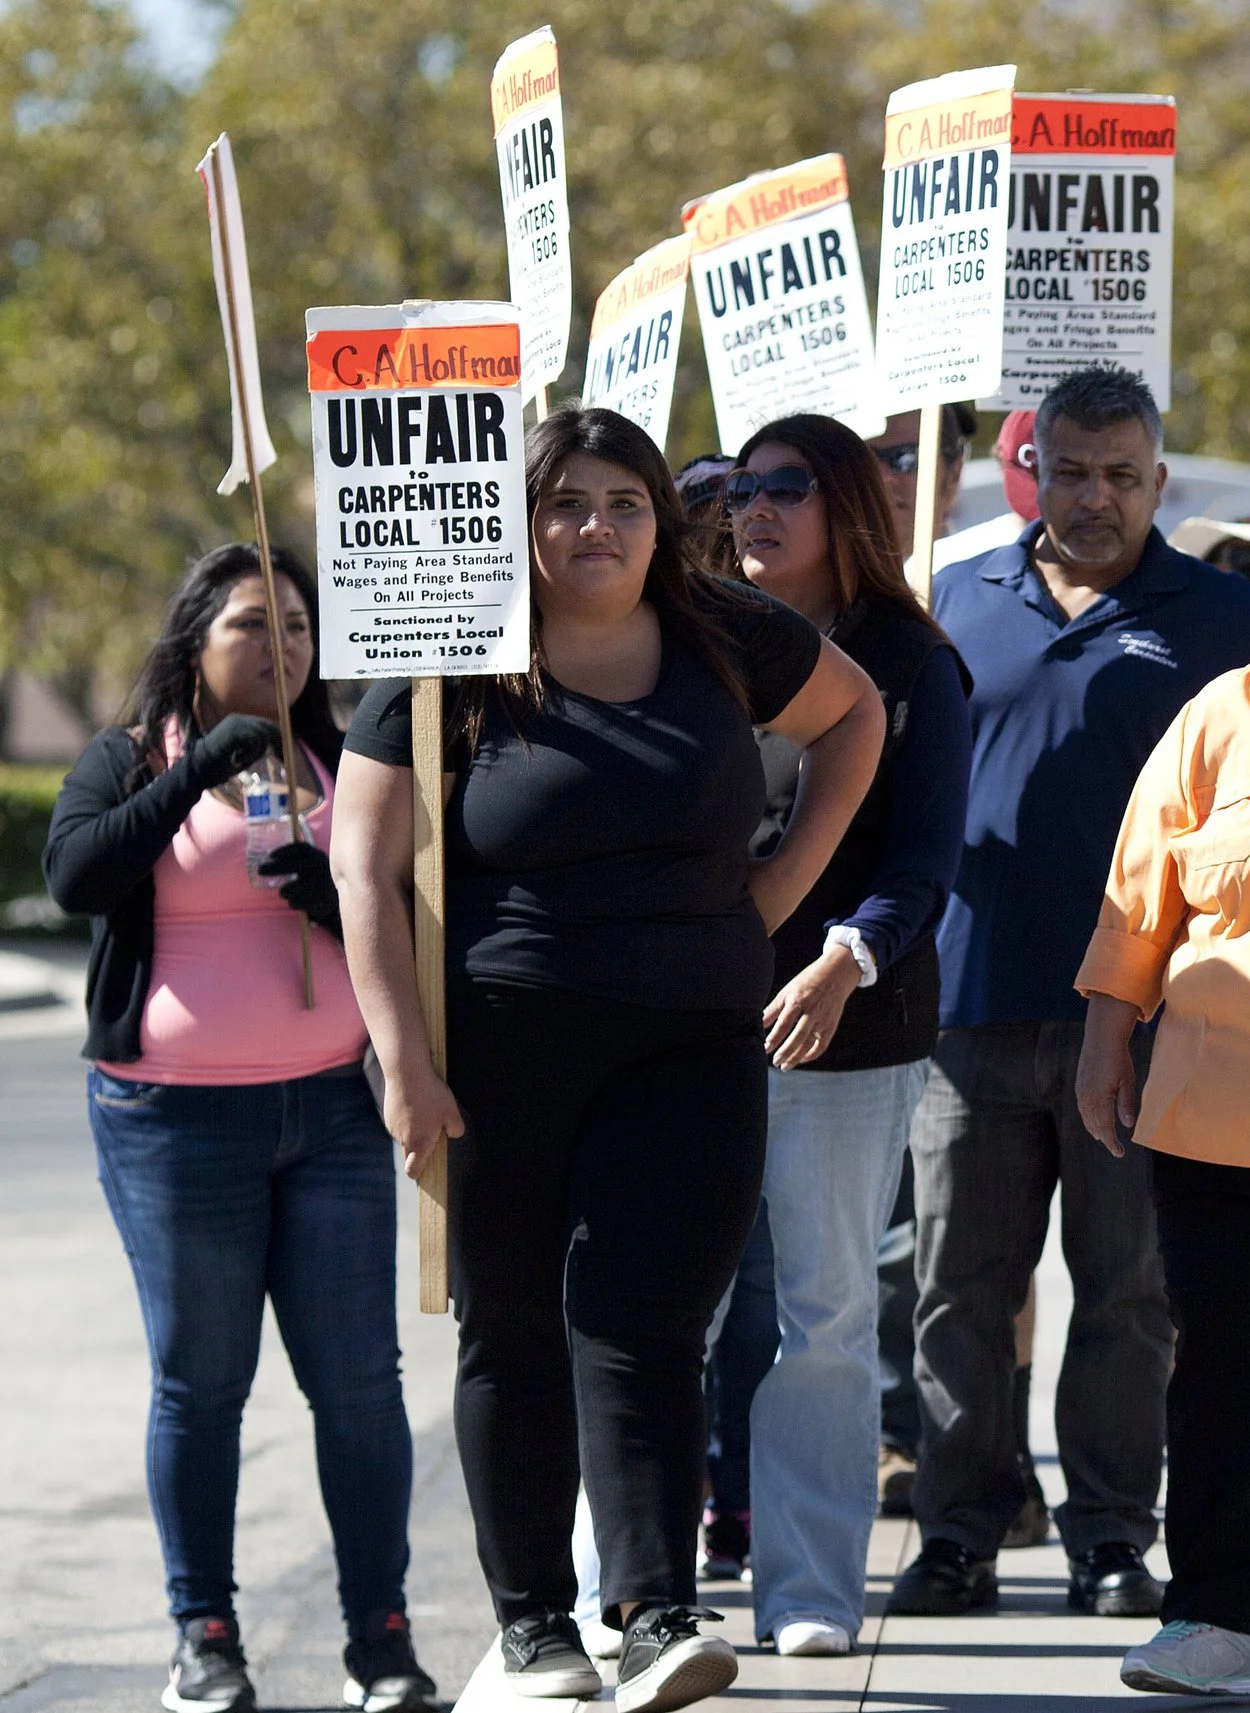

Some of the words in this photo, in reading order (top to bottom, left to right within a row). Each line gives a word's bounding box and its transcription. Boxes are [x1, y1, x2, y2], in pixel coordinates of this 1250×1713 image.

[1063, 113, 1175, 148] Hoffman
[892, 149, 999, 229] UNFAIR
[531, 231, 558, 265] 1506
[894, 227, 989, 269] CARPENTERS
[706, 229, 847, 318] UNFAIR
[895, 268, 935, 299] LOCAL
[1005, 277, 1074, 301] LOCAL
[722, 296, 845, 351] CARPENTERS
[1018, 309, 1058, 321] Paying
[1066, 309, 1095, 319] Area
[1101, 310, 1156, 320] Standard
[1035, 325, 1058, 334] and
[1063, 324, 1101, 336] Fringe
[1106, 324, 1155, 334] Benefits
[589, 309, 673, 403] UNFAIR
[730, 341, 786, 377] LOCAL
[801, 322, 846, 352] 1506
[1026, 338, 1042, 348] On
[1069, 338, 1118, 350] Projects
[327, 392, 508, 468] UNFAIR
[409, 470, 429, 480] to
[338, 481, 500, 514] CARPENTERS
[340, 518, 420, 548] LOCAL
[431, 515, 502, 545] #1506
[332, 559, 356, 571] Not
[364, 557, 408, 571] Paying
[415, 556, 446, 568] Area
[453, 552, 513, 566] Standard
[332, 576, 377, 589] Wages
[384, 574, 408, 586] and
[414, 573, 454, 586] Fringe
[460, 570, 514, 583] Benefits
[373, 592, 390, 603] On
[397, 591, 414, 602] All
[421, 589, 474, 602] Projects
[348, 630, 450, 644] Carpenters
[456, 626, 504, 639] Local
[374, 614, 452, 626] Sanctioned
[457, 614, 475, 625] by
[365, 647, 422, 659] Union
[432, 644, 487, 657] #1506
